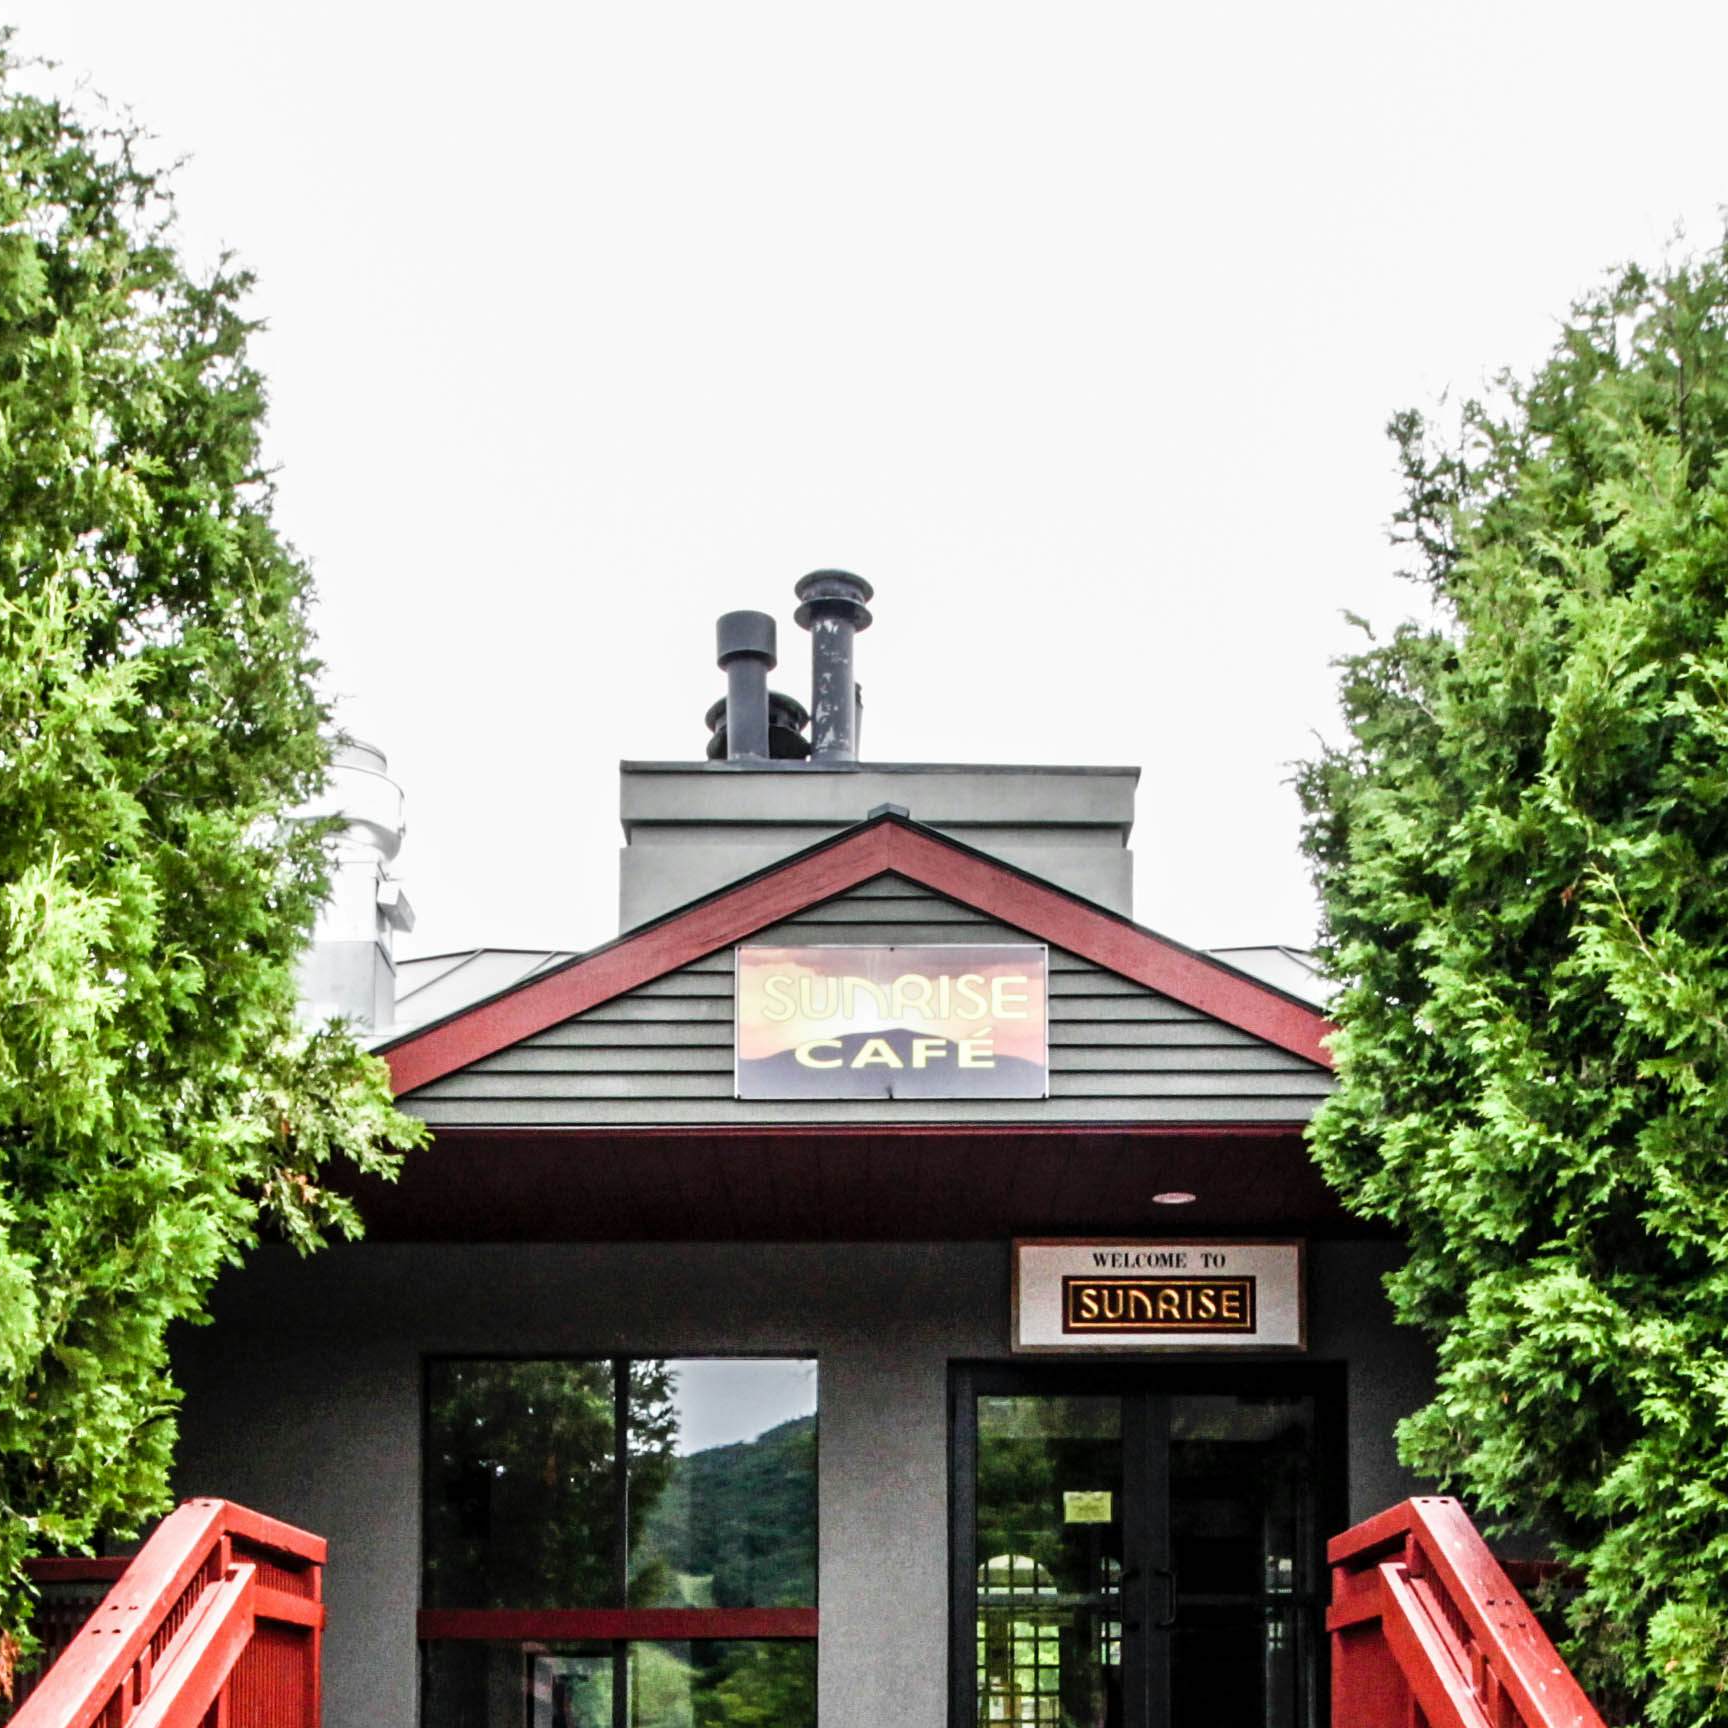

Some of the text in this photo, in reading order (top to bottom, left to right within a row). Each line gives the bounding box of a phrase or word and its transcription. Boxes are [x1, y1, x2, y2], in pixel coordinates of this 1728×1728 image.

[761, 973, 1028, 1022] SUNRISE
[794, 1027, 996, 1069] CAFÉ
[1092, 1252, 1226, 1269] WELCOME TO
[1080, 1288, 1240, 1320] SUNRISE
